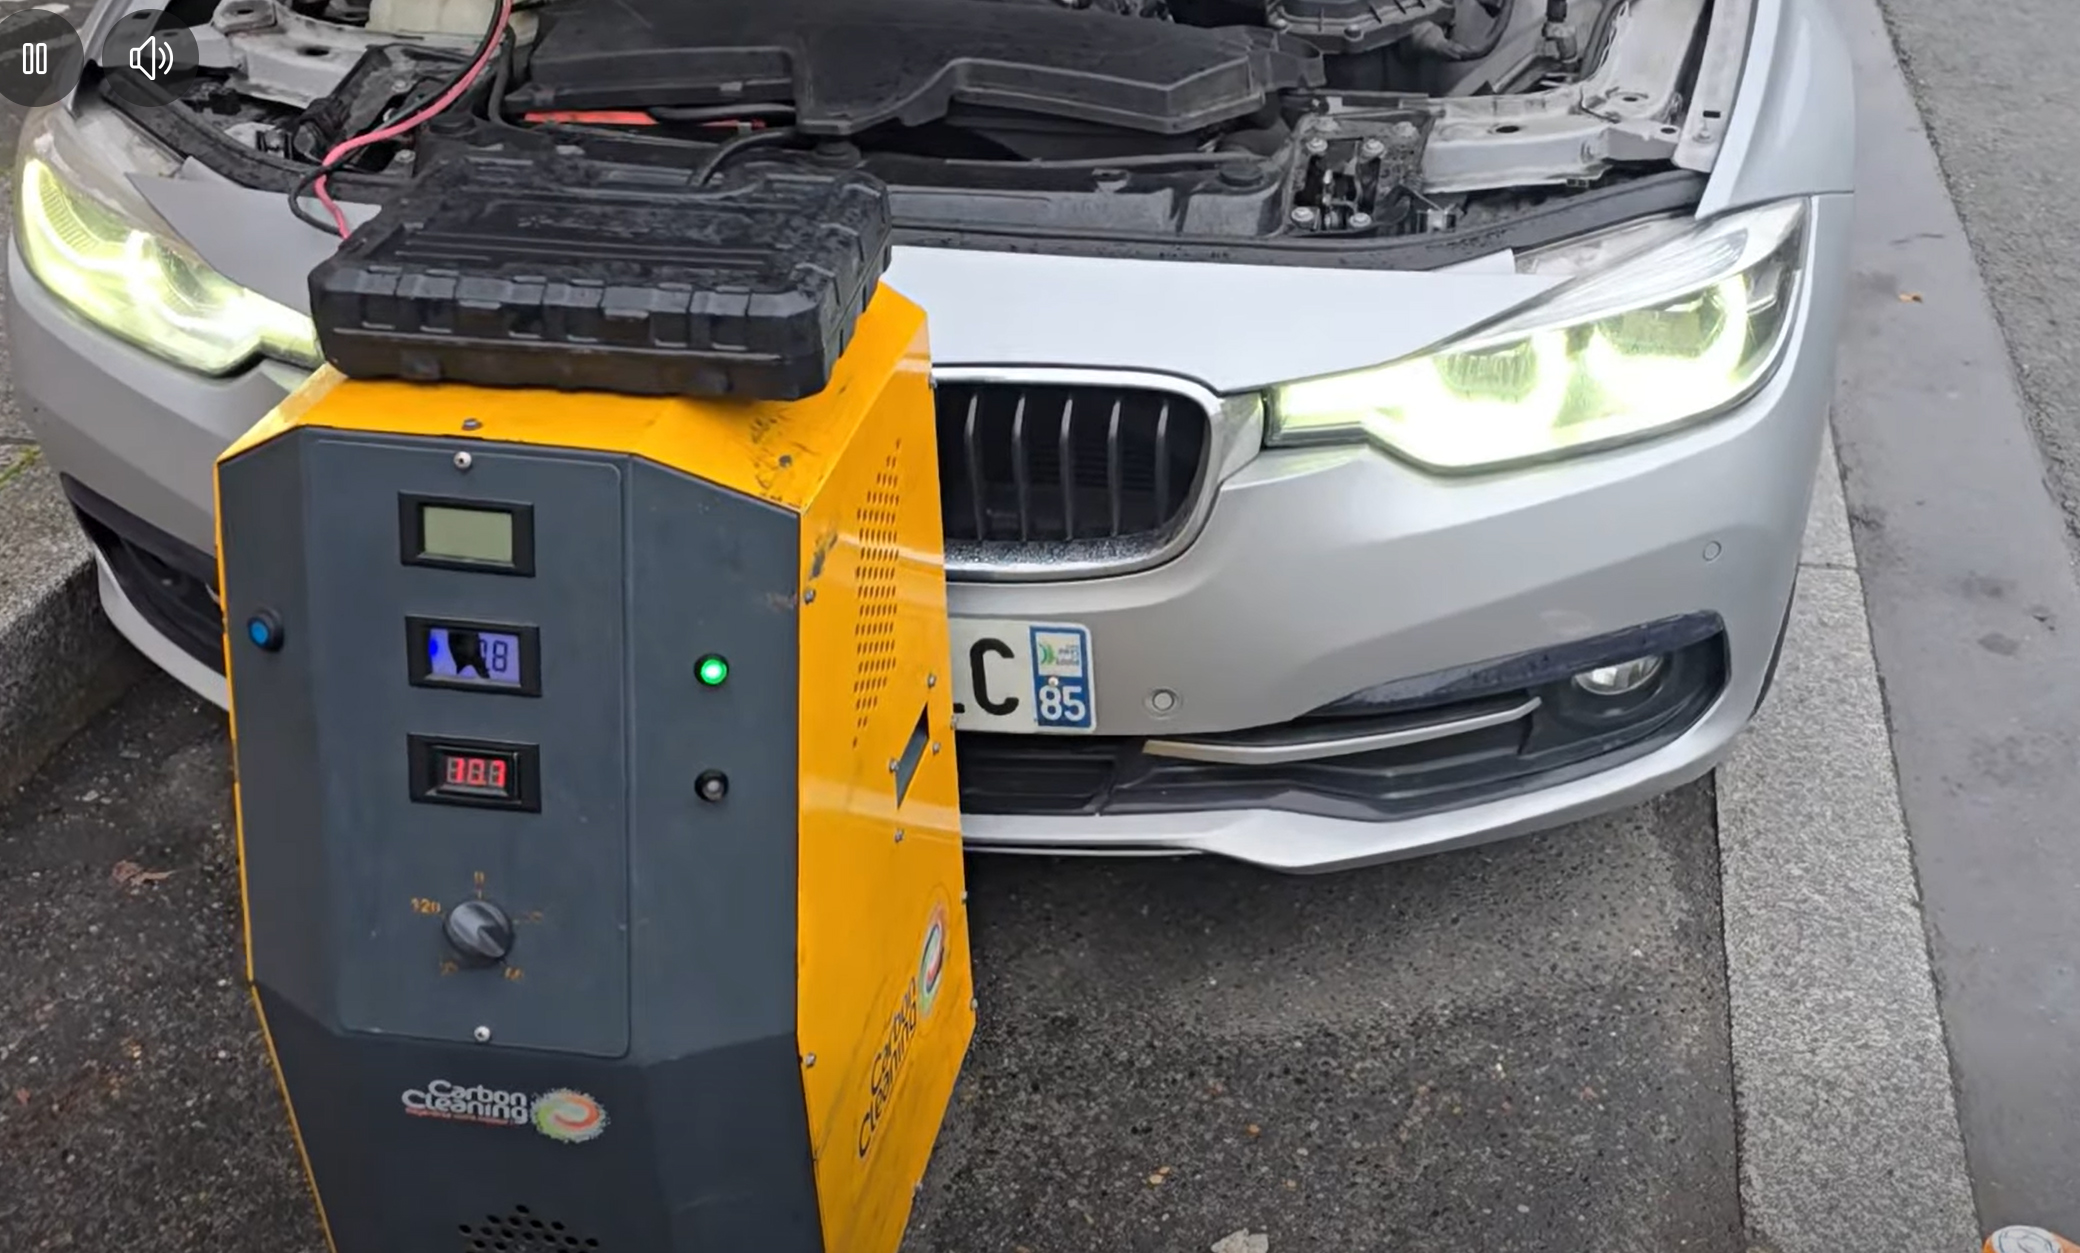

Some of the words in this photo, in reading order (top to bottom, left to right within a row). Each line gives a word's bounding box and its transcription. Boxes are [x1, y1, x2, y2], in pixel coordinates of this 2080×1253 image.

[953, 638, 1019, 716] C
[1039, 685, 1086, 721] 85
[870, 976, 916, 1096] Carbon
[401, 1089, 528, 1125] Cleaning
[428, 1079, 527, 1107] Carbon
